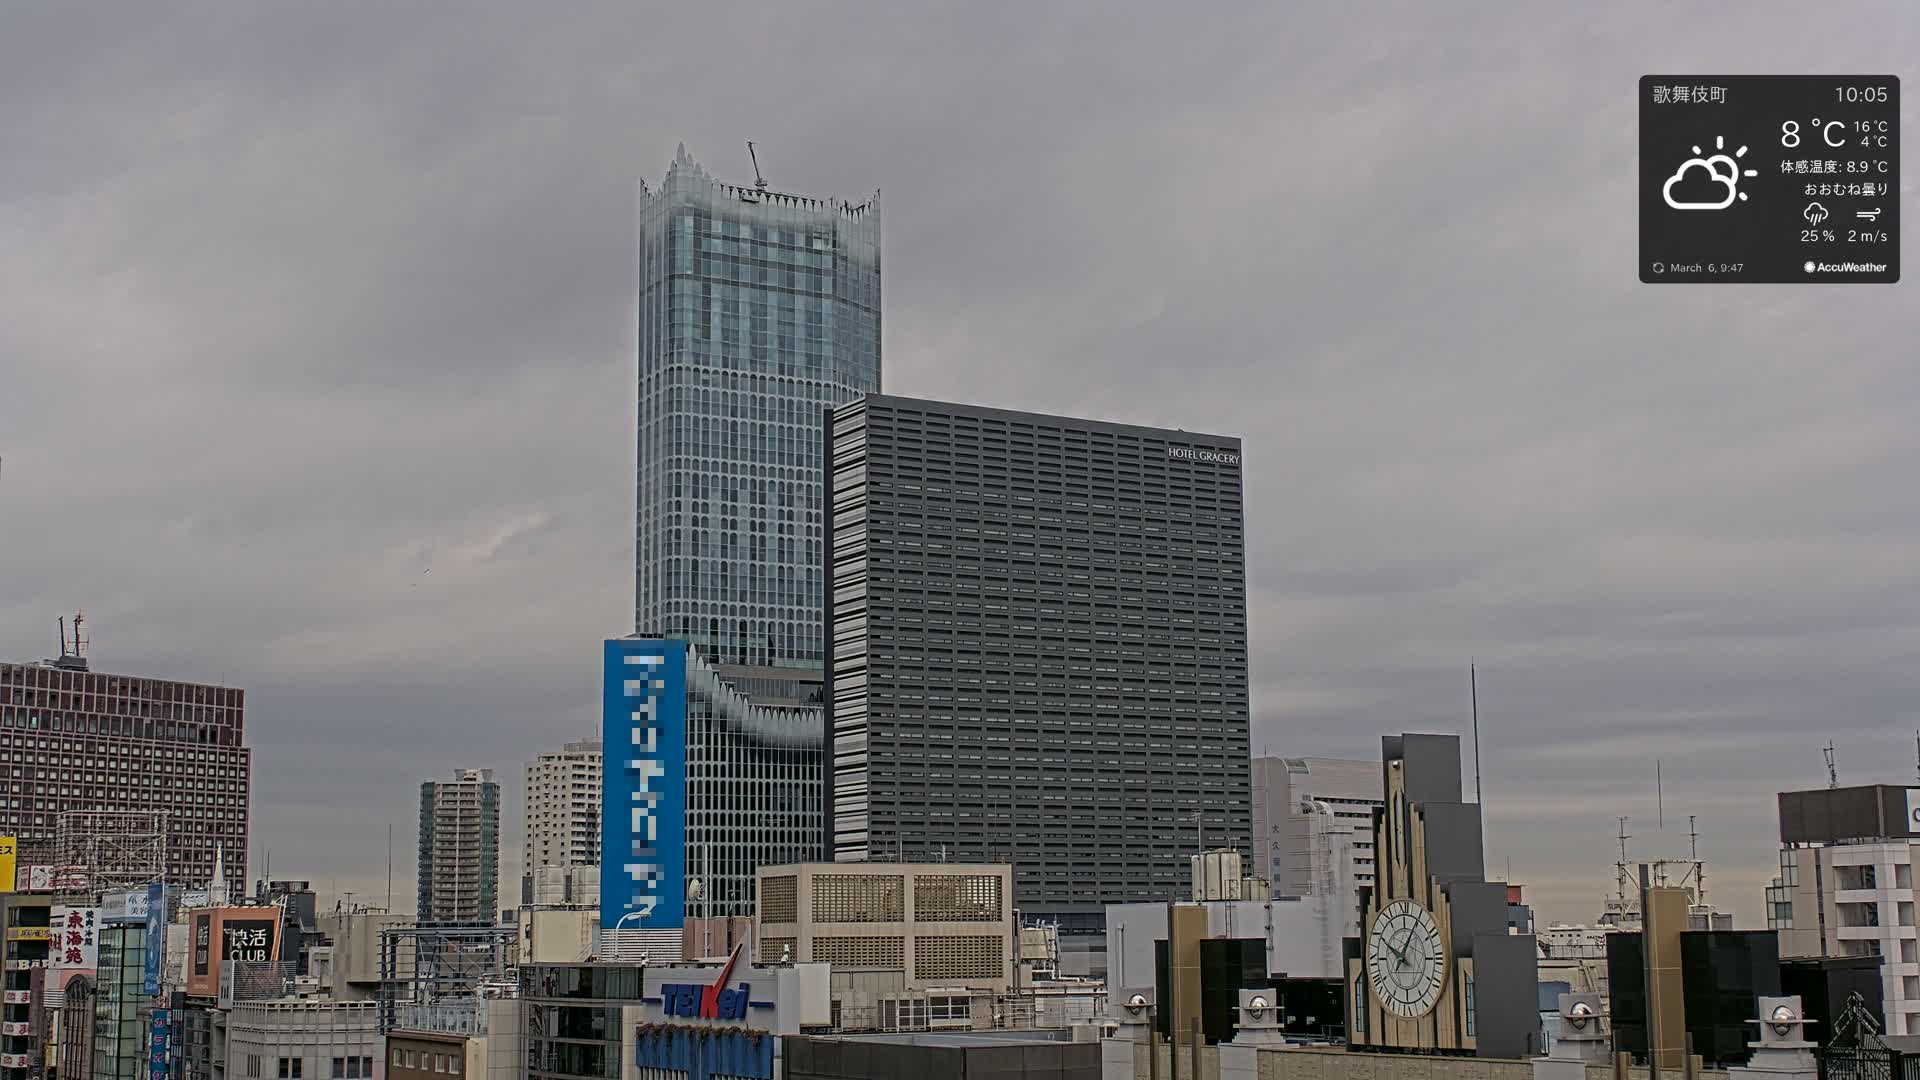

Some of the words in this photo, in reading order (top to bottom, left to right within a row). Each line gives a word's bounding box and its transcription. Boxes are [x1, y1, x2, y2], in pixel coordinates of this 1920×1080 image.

[1168, 448, 1198, 460] HOTEL
[1199, 451, 1240, 464] GRACERY
[64, 910, 84, 964] 東海苑
[231, 928, 267, 947] 快活
[230, 948, 267, 962] CLUB
